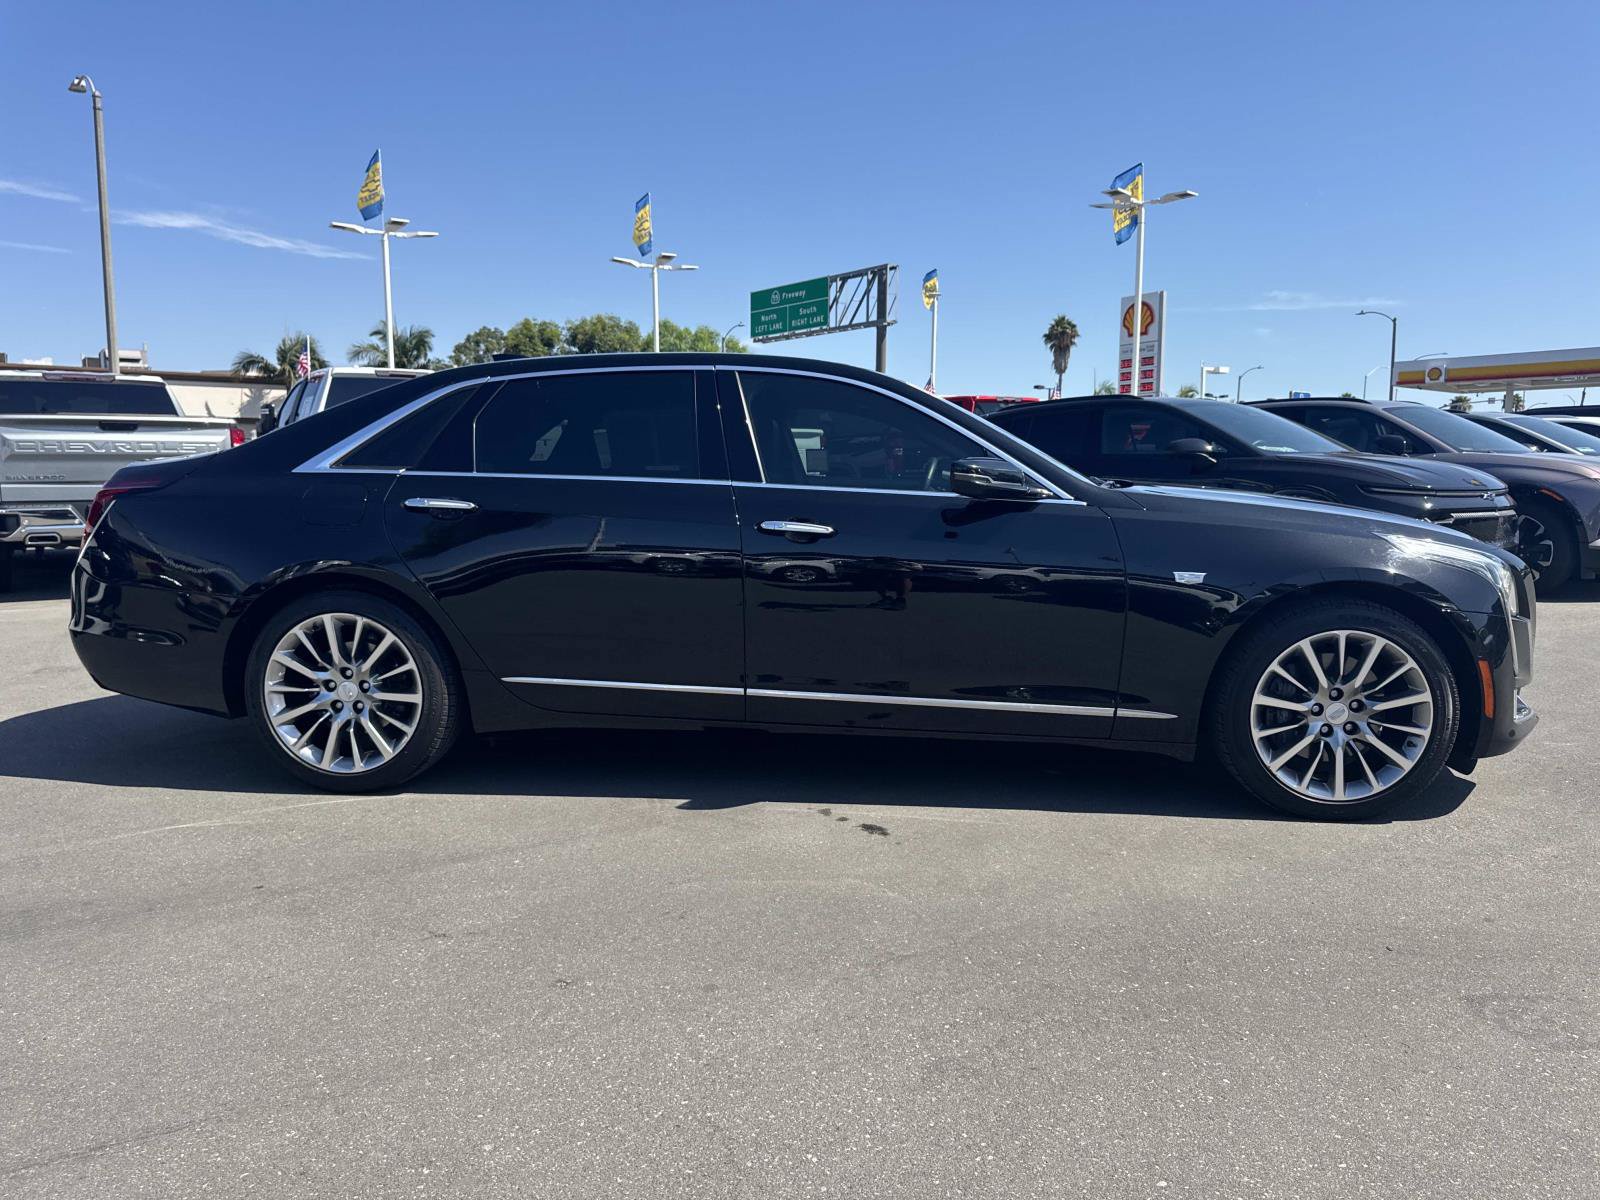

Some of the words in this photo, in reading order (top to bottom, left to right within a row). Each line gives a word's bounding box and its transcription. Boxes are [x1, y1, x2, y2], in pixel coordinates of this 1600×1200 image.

[782, 290, 806, 300] Freeway
[800, 306, 816, 315] South
[762, 314, 776, 322] North
[792, 318, 807, 326] RIGHT
[810, 315, 824, 324] LANE
[756, 325, 768, 333] LEFT
[770, 322, 783, 330] LANE
[13, 441, 221, 454] CHEVROLET
